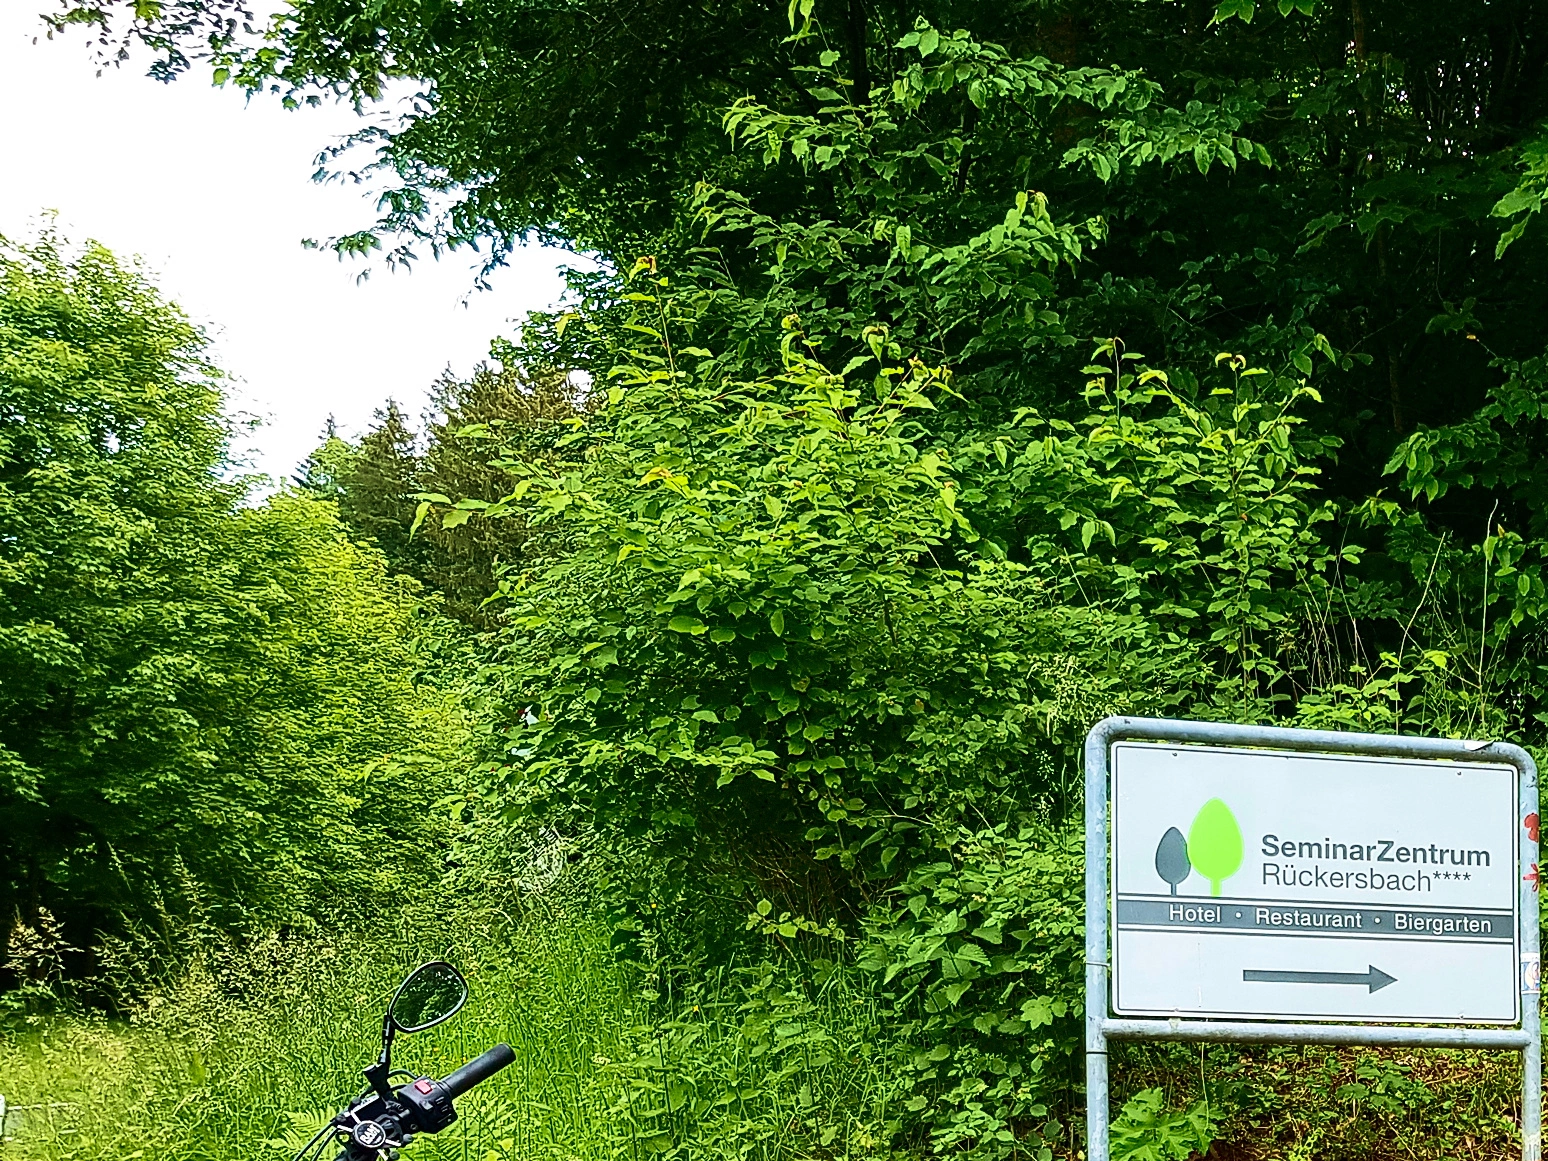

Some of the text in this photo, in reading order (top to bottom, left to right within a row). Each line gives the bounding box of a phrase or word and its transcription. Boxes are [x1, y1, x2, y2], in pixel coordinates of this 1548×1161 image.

[1261, 834, 1491, 867] SeminarZentrum
[1168, 904, 1492, 936] Hotel Restaurant Biergarten
